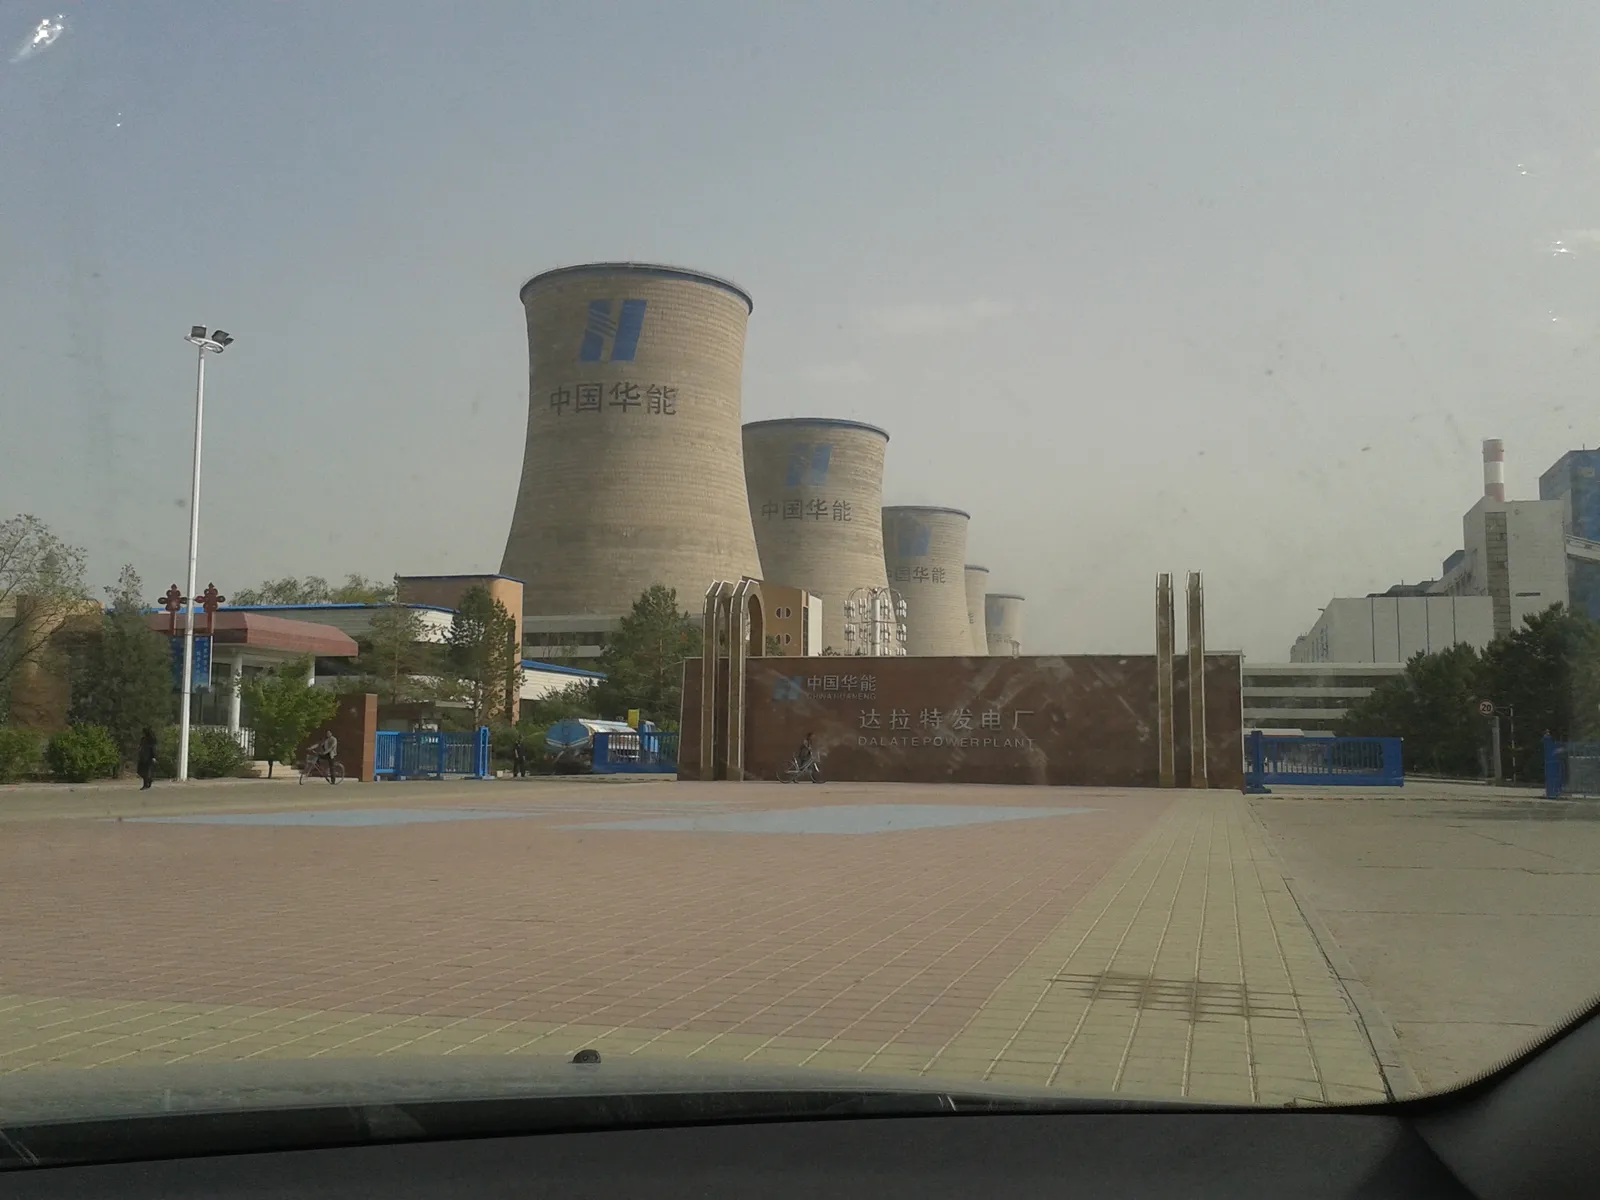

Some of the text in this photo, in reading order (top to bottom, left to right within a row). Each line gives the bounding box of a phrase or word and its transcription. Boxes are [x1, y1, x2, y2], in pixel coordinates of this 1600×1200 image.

[550, 381, 678, 416] 中国华能
[761, 498, 852, 522] 中国华能
[807, 675, 876, 691] 中国华能
[1482, 703, 1492, 711] 20
[859, 708, 1035, 730] 达拉特发电厂
[858, 736, 1035, 749] DALATE POWER PLANT
